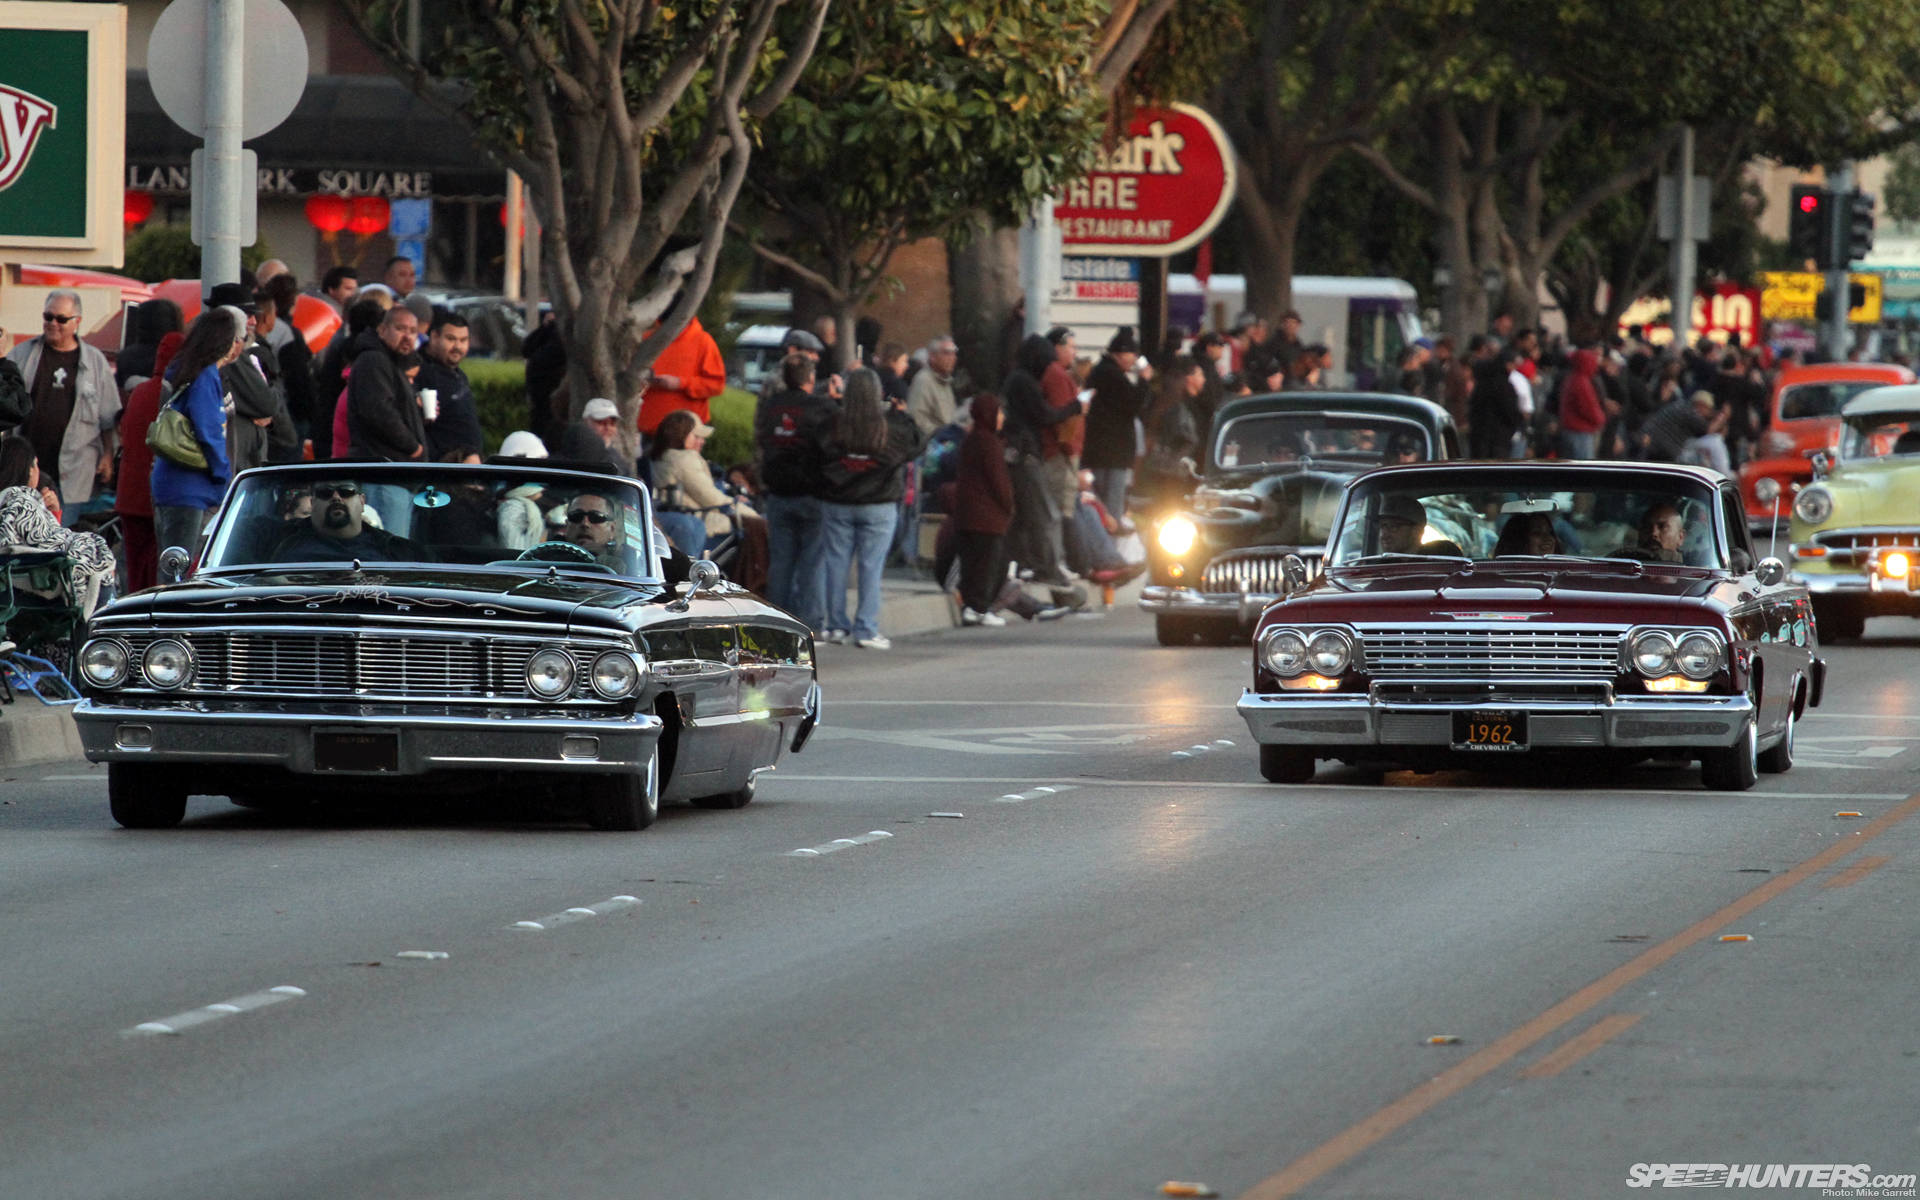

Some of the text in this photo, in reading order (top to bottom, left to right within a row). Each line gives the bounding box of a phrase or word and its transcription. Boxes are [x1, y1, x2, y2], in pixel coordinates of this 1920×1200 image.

[129, 166, 432, 198] LANRK SQUARE
[224, 602, 497, 616] FORD
[1467, 723, 1513, 744] 1962
